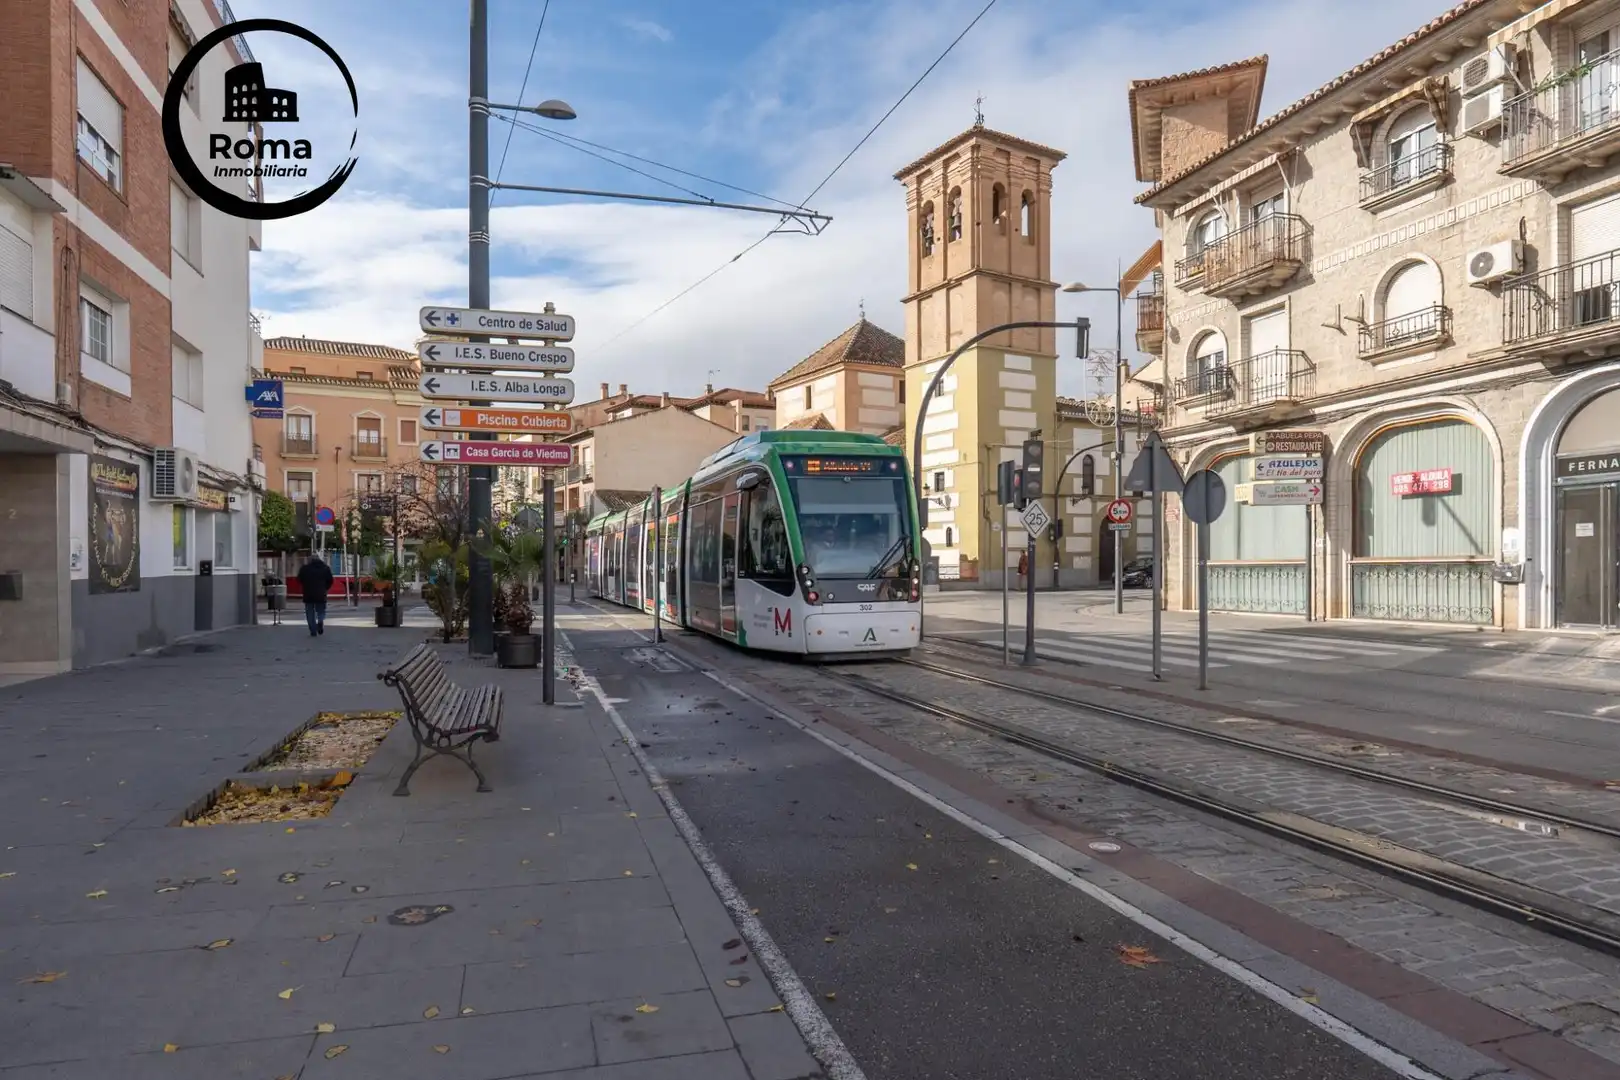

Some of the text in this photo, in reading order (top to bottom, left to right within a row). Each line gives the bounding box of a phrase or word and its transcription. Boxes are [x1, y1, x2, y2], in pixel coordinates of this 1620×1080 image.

[478, 316, 567, 331] Centro de Salud
[455, 347, 567, 364] I.E.S. Bueno Crespo
[471, 380, 566, 396] I.E.S. Alba Longa
[256, 391, 279, 401] AXA
[477, 414, 567, 428] Piscina Cubierta
[466, 446, 568, 459] Casa García de Viedma
[1276, 442, 1322, 451] RESTAURANTE
[1269, 460, 1318, 468] AZULEJOS
[1569, 459, 1619, 471] FERNA
[8, 509, 17, 519] 2
[1029, 513, 1043, 525] 25
[858, 584, 876, 592] CAF
[774, 607, 791, 634] M
